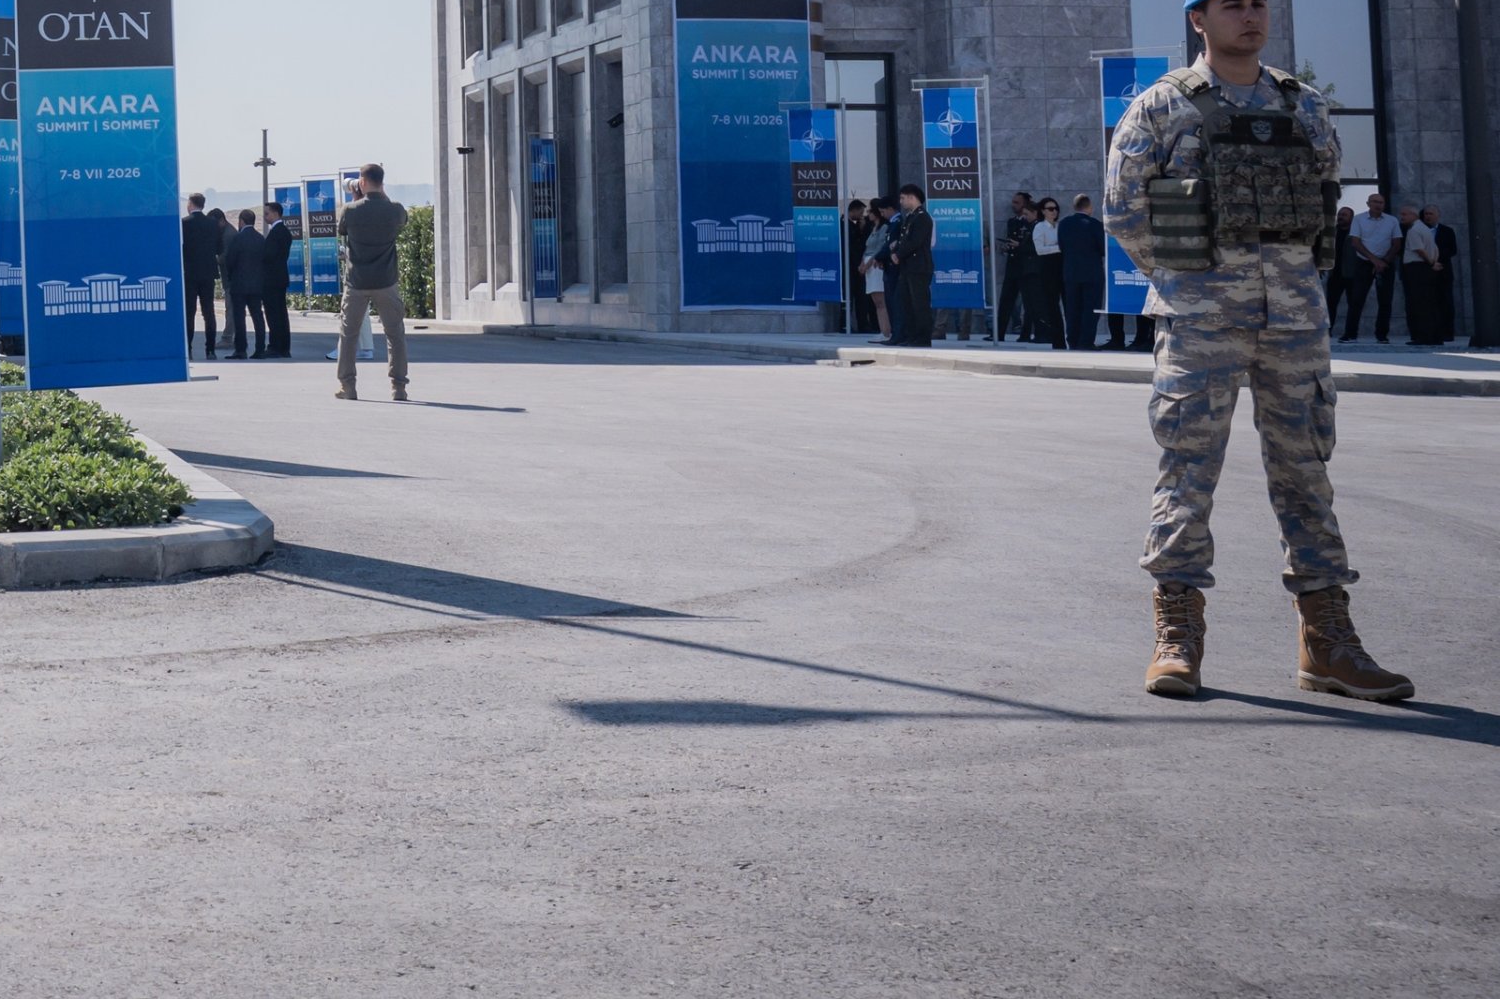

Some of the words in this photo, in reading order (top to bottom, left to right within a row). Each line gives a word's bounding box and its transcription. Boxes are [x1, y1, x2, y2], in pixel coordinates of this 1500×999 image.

[38, 11, 151, 41] OTAN
[691, 45, 798, 63] ANKARA
[692, 69, 739, 79] SUMMIT
[749, 69, 799, 80] SOMMET
[36, 94, 160, 116] ANKARA
[37, 121, 89, 132] SUMMIT
[102, 119, 160, 131] SOMMET
[711, 115, 730, 125] 7-8
[734, 115, 749, 125] VII
[753, 115, 783, 125] 2026
[932, 156, 971, 168] NATO
[60, 169, 81, 180] 7-8
[85, 169, 102, 179] VII
[107, 167, 141, 179] 2026
[797, 169, 831, 179] NATO
[933, 179, 973, 190] OTAN
[797, 189, 832, 199] OTAN
[933, 207, 975, 215] ANKARA
[797, 214, 834, 222] ANKARA
